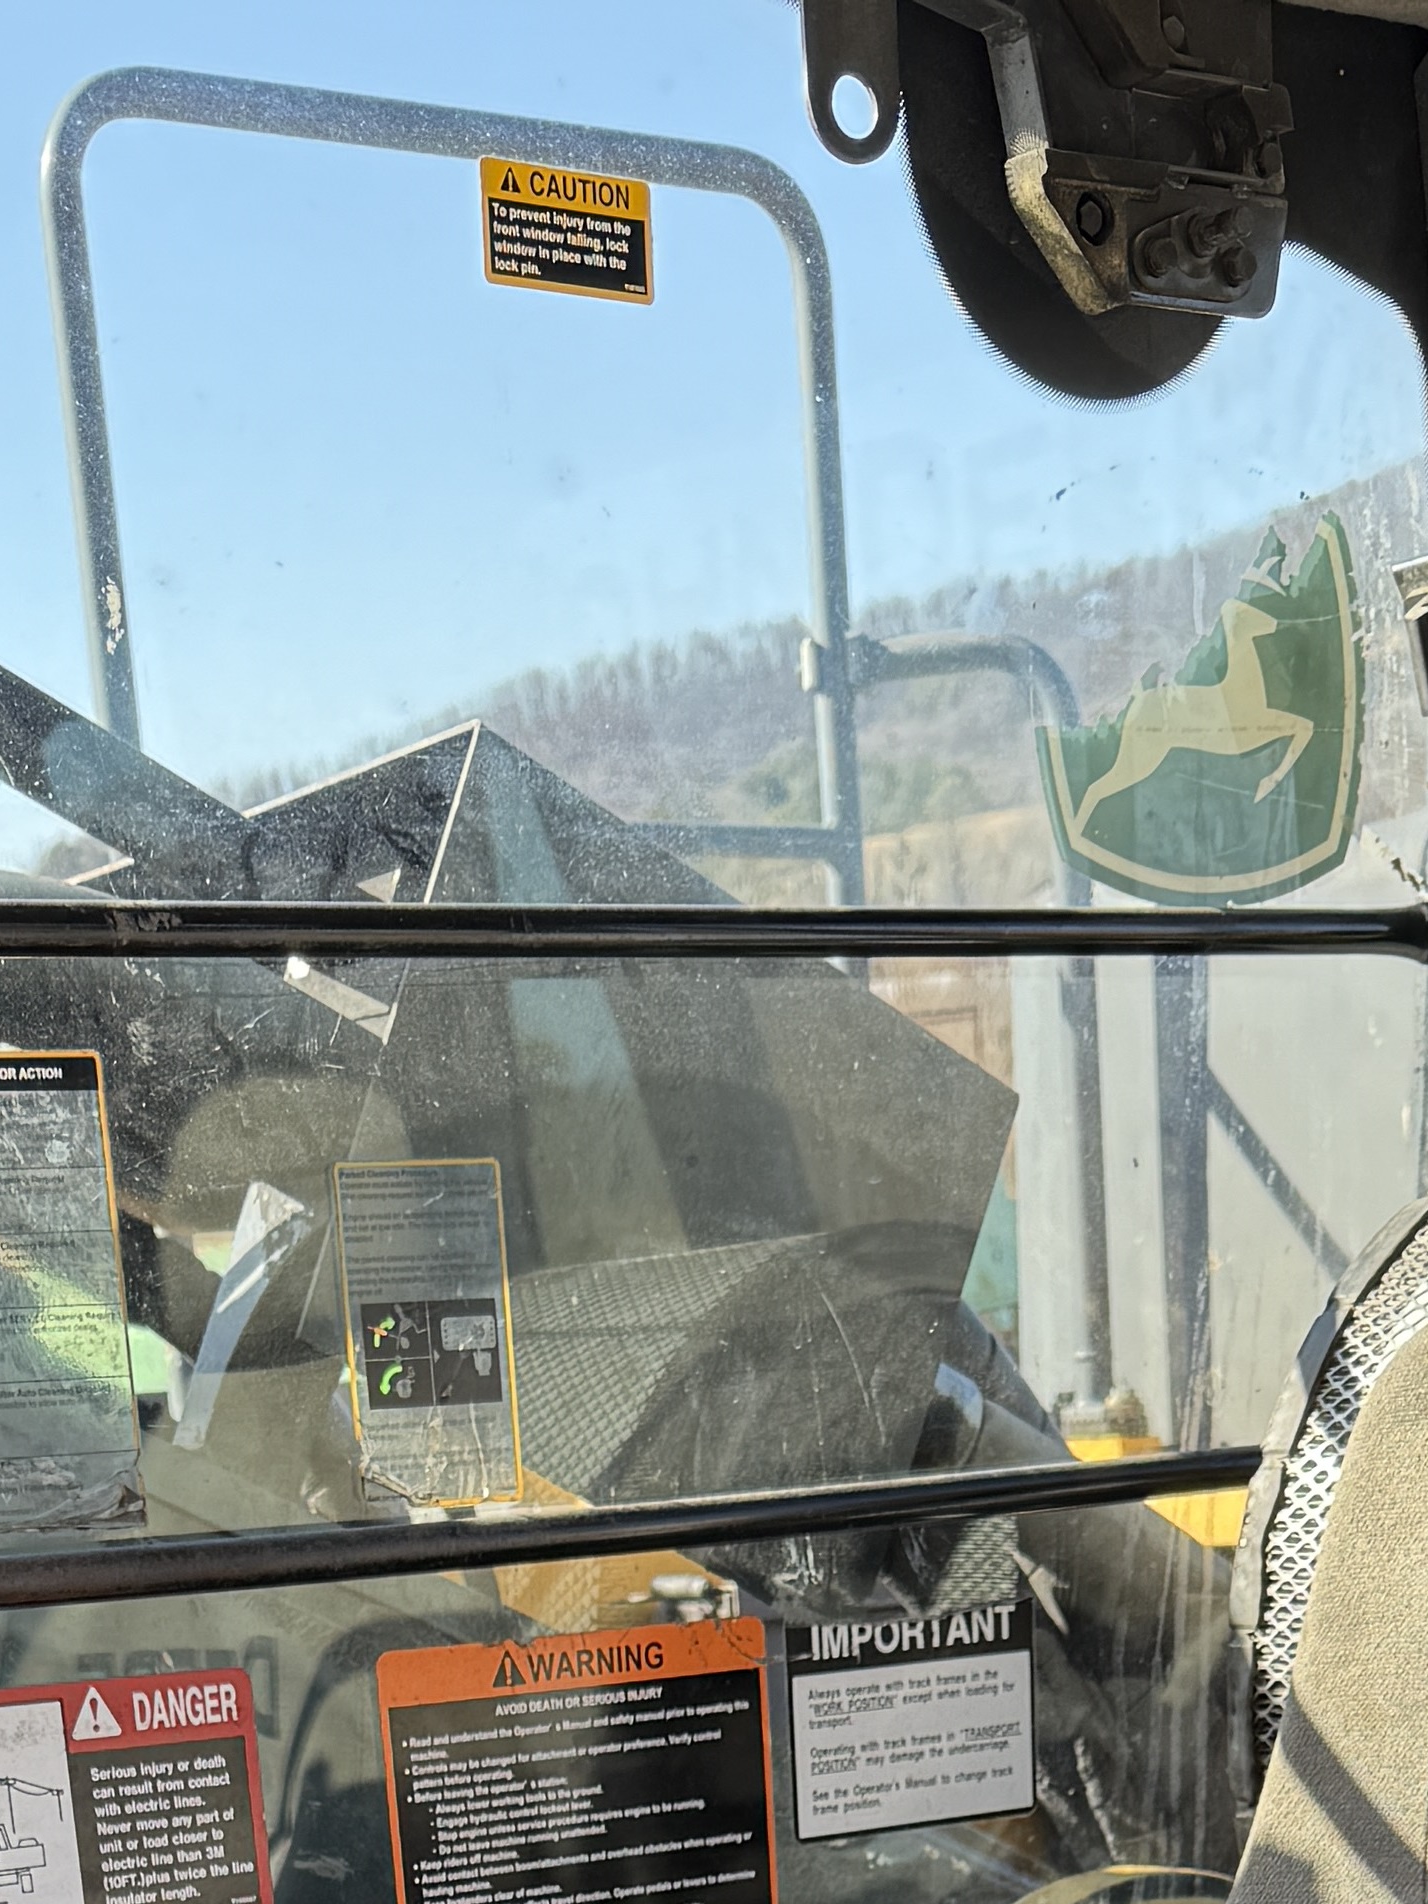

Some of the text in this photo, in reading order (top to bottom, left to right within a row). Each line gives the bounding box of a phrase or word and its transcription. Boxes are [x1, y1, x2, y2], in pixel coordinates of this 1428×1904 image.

[529, 170, 629, 209] CAUTION
[491, 202, 631, 236] To prevent injury from the
[492, 221, 629, 253] front window falling, lock
[494, 239, 626, 270] window in place with the
[495, 256, 541, 277] lock pin.
[18, 1065, 63, 1080] ACTION
[527, 1641, 663, 1682] WARNING
[808, 1667, 997, 1702] Always operate with track frames in the
[132, 1682, 238, 1731] DANGER
[494, 1686, 663, 1716] AVOID DEATH OR SERIOUS INJURY
[810, 1742, 855, 1759] Operating
[860, 1739, 878, 1753] with
[883, 1736, 906, 1750] track
[911, 1731, 941, 1747] frames
[946, 1730, 954, 1743] in
[90, 1754, 226, 1782] Serious injury or death
[92, 1772, 230, 1799] can result from contact
[812, 1765, 1012, 1801] See the Operator's Manual to change track
[94, 1793, 206, 1817] with electric lines.
[813, 1802, 838, 1816] frame
[96, 1807, 234, 1835] Never move any part of
[98, 1827, 224, 1854] unit or load closer to
[100, 1845, 224, 1872] electric line than 3M
[173, 1864, 206, 1881] twice
[209, 1862, 229, 1877] the
[231, 1859, 254, 1874] line
[160, 1883, 201, 1903] length.
